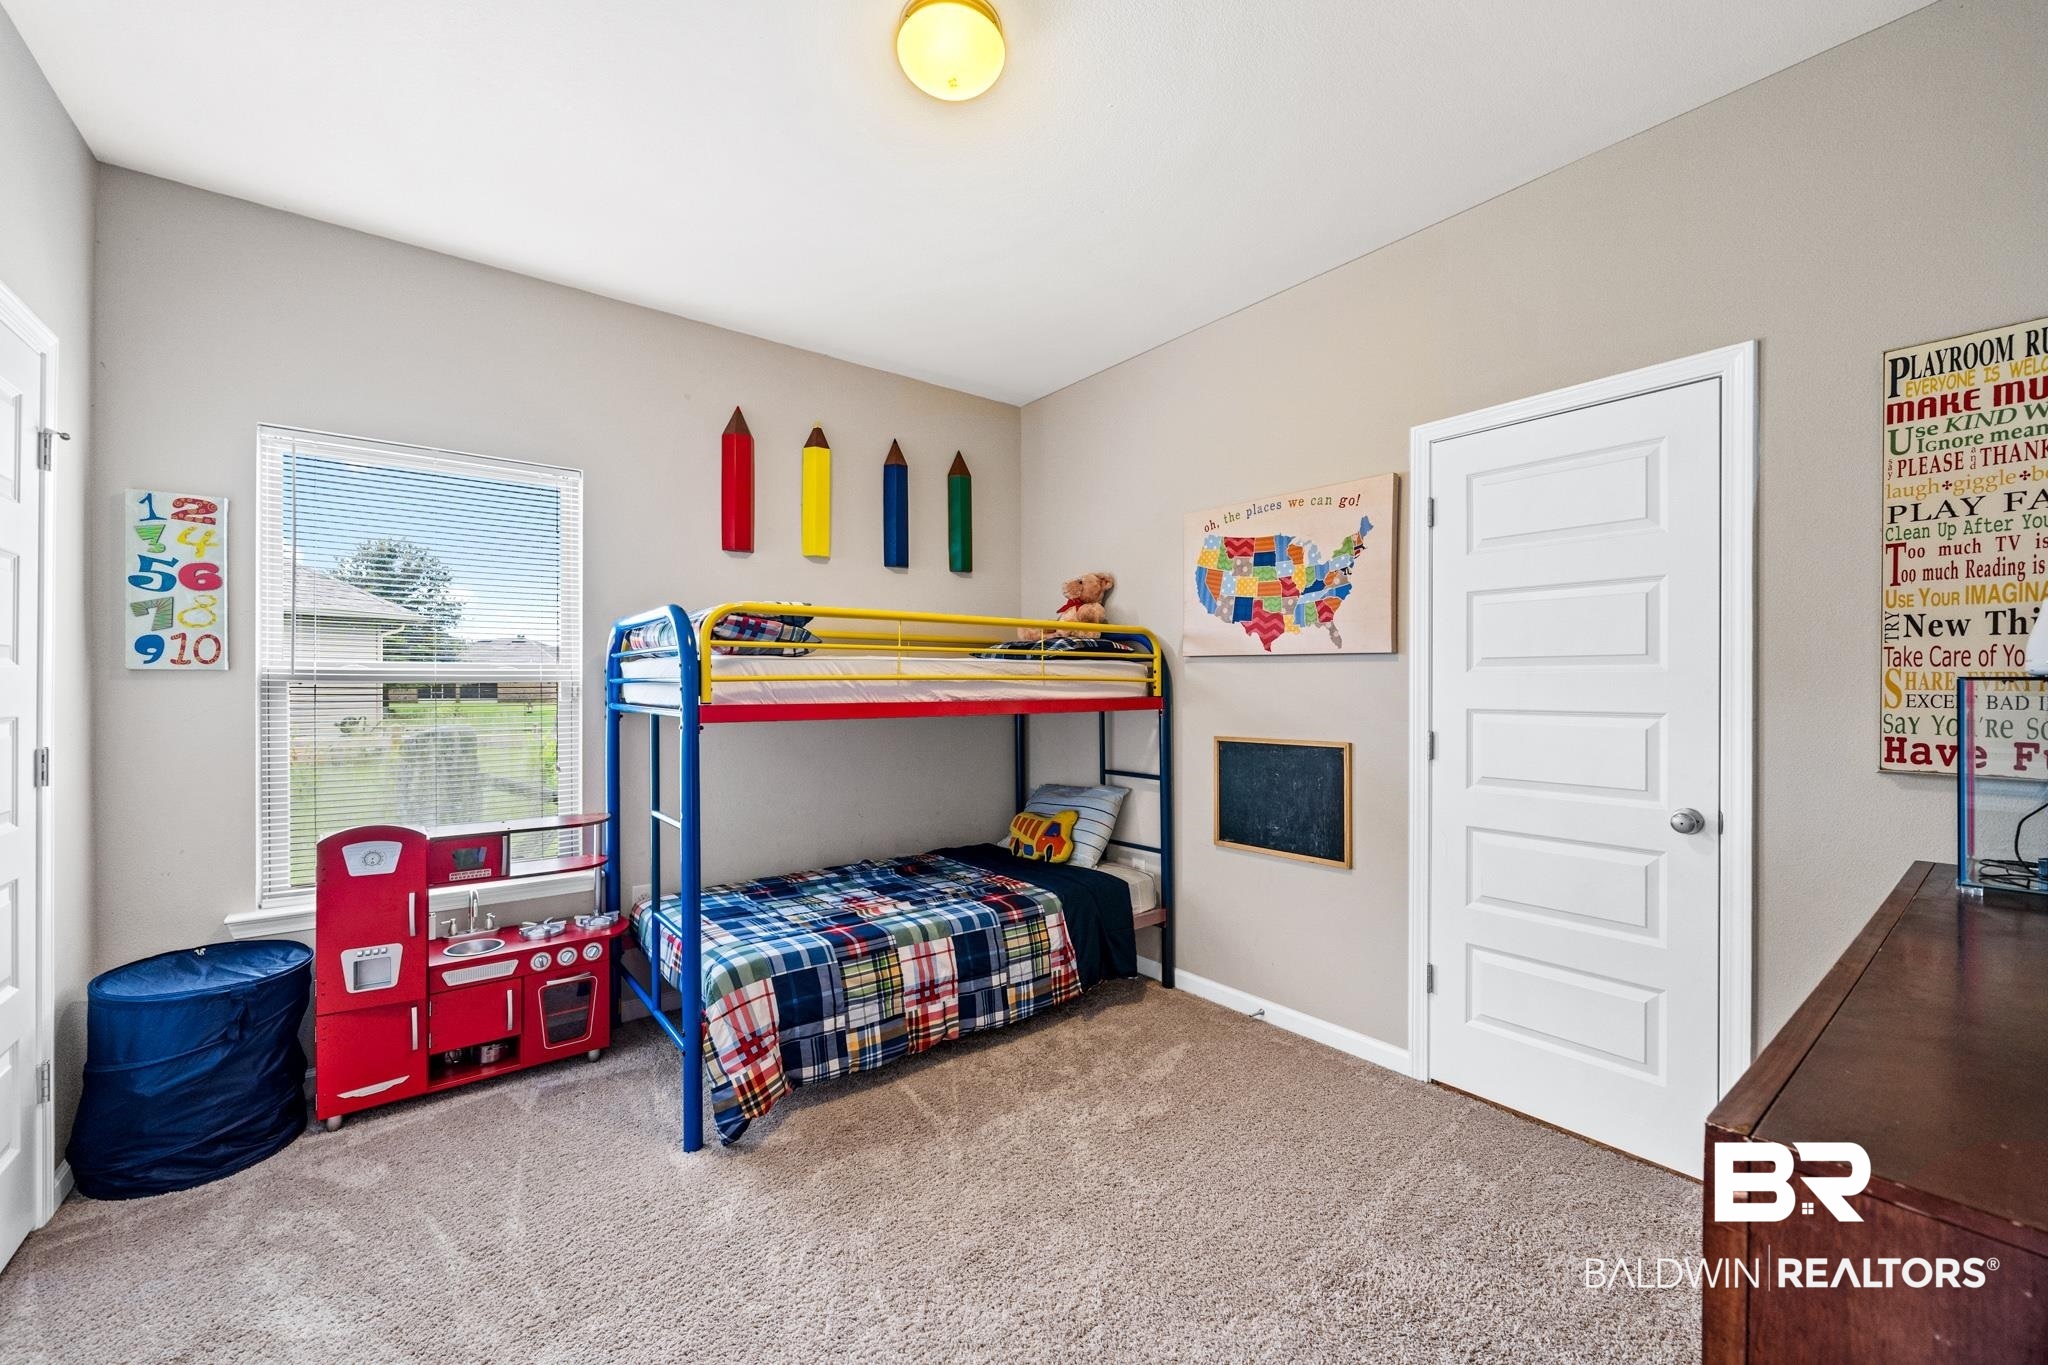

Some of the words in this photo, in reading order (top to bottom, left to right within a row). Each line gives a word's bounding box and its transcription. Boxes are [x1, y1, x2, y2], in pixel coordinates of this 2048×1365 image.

[1888, 334, 2014, 398] PLAYROOM
[1906, 369, 1976, 398] EVERYONE
[1984, 365, 2001, 383] IS
[1888, 425, 1938, 456] Use
[1944, 407, 2017, 434] KIND
[1897, 451, 1964, 478] PLEASE
[1886, 477, 1940, 501] laugh
[1952, 468, 2017, 496] giggle
[2031, 464, 2048, 482] b
[138, 493, 167, 522] 1
[171, 497, 218, 525] 2
[1203, 519, 1220, 534] oh,
[1223, 511, 1241, 524] the
[1245, 500, 1282, 519] places
[1288, 497, 1305, 508] we
[1310, 496, 1333, 507] can
[1338, 493, 1361, 509] go!
[1887, 495, 1986, 525] PLAY
[2003, 488, 2048, 513] FA
[134, 524, 167, 554] 3
[177, 526, 219, 559] 4
[1885, 525, 1931, 542] Clean
[1938, 522, 1957, 541] Up
[1964, 517, 2014, 536] After
[128, 554, 179, 593] 5
[178, 562, 223, 592] 6
[1886, 542, 1926, 586] Too
[1938, 537, 1982, 557] much
[1995, 534, 2021, 552] TV
[2035, 532, 2048, 549] is
[1922, 560, 1959, 582] much
[1965, 556, 2026, 582] Reading
[2032, 554, 2046, 575] is
[130, 596, 174, 632] 7
[177, 594, 218, 628] 8
[1884, 610, 1900, 644] TRY
[1904, 613, 1972, 638] New
[134, 634, 165, 665] 9
[170, 632, 222, 665] 10
[1884, 646, 1923, 668] Take
[1929, 645, 1971, 668] Care
[1978, 644, 1998, 667] of
[2003, 644, 2025, 667] Yo
[1884, 667, 1955, 709] SHARE
[1906, 694, 1977, 709] EXCE
[1987, 695, 2030, 711] BAD
[1884, 736, 1988, 769] Have
[2013, 742, 2048, 772] F
